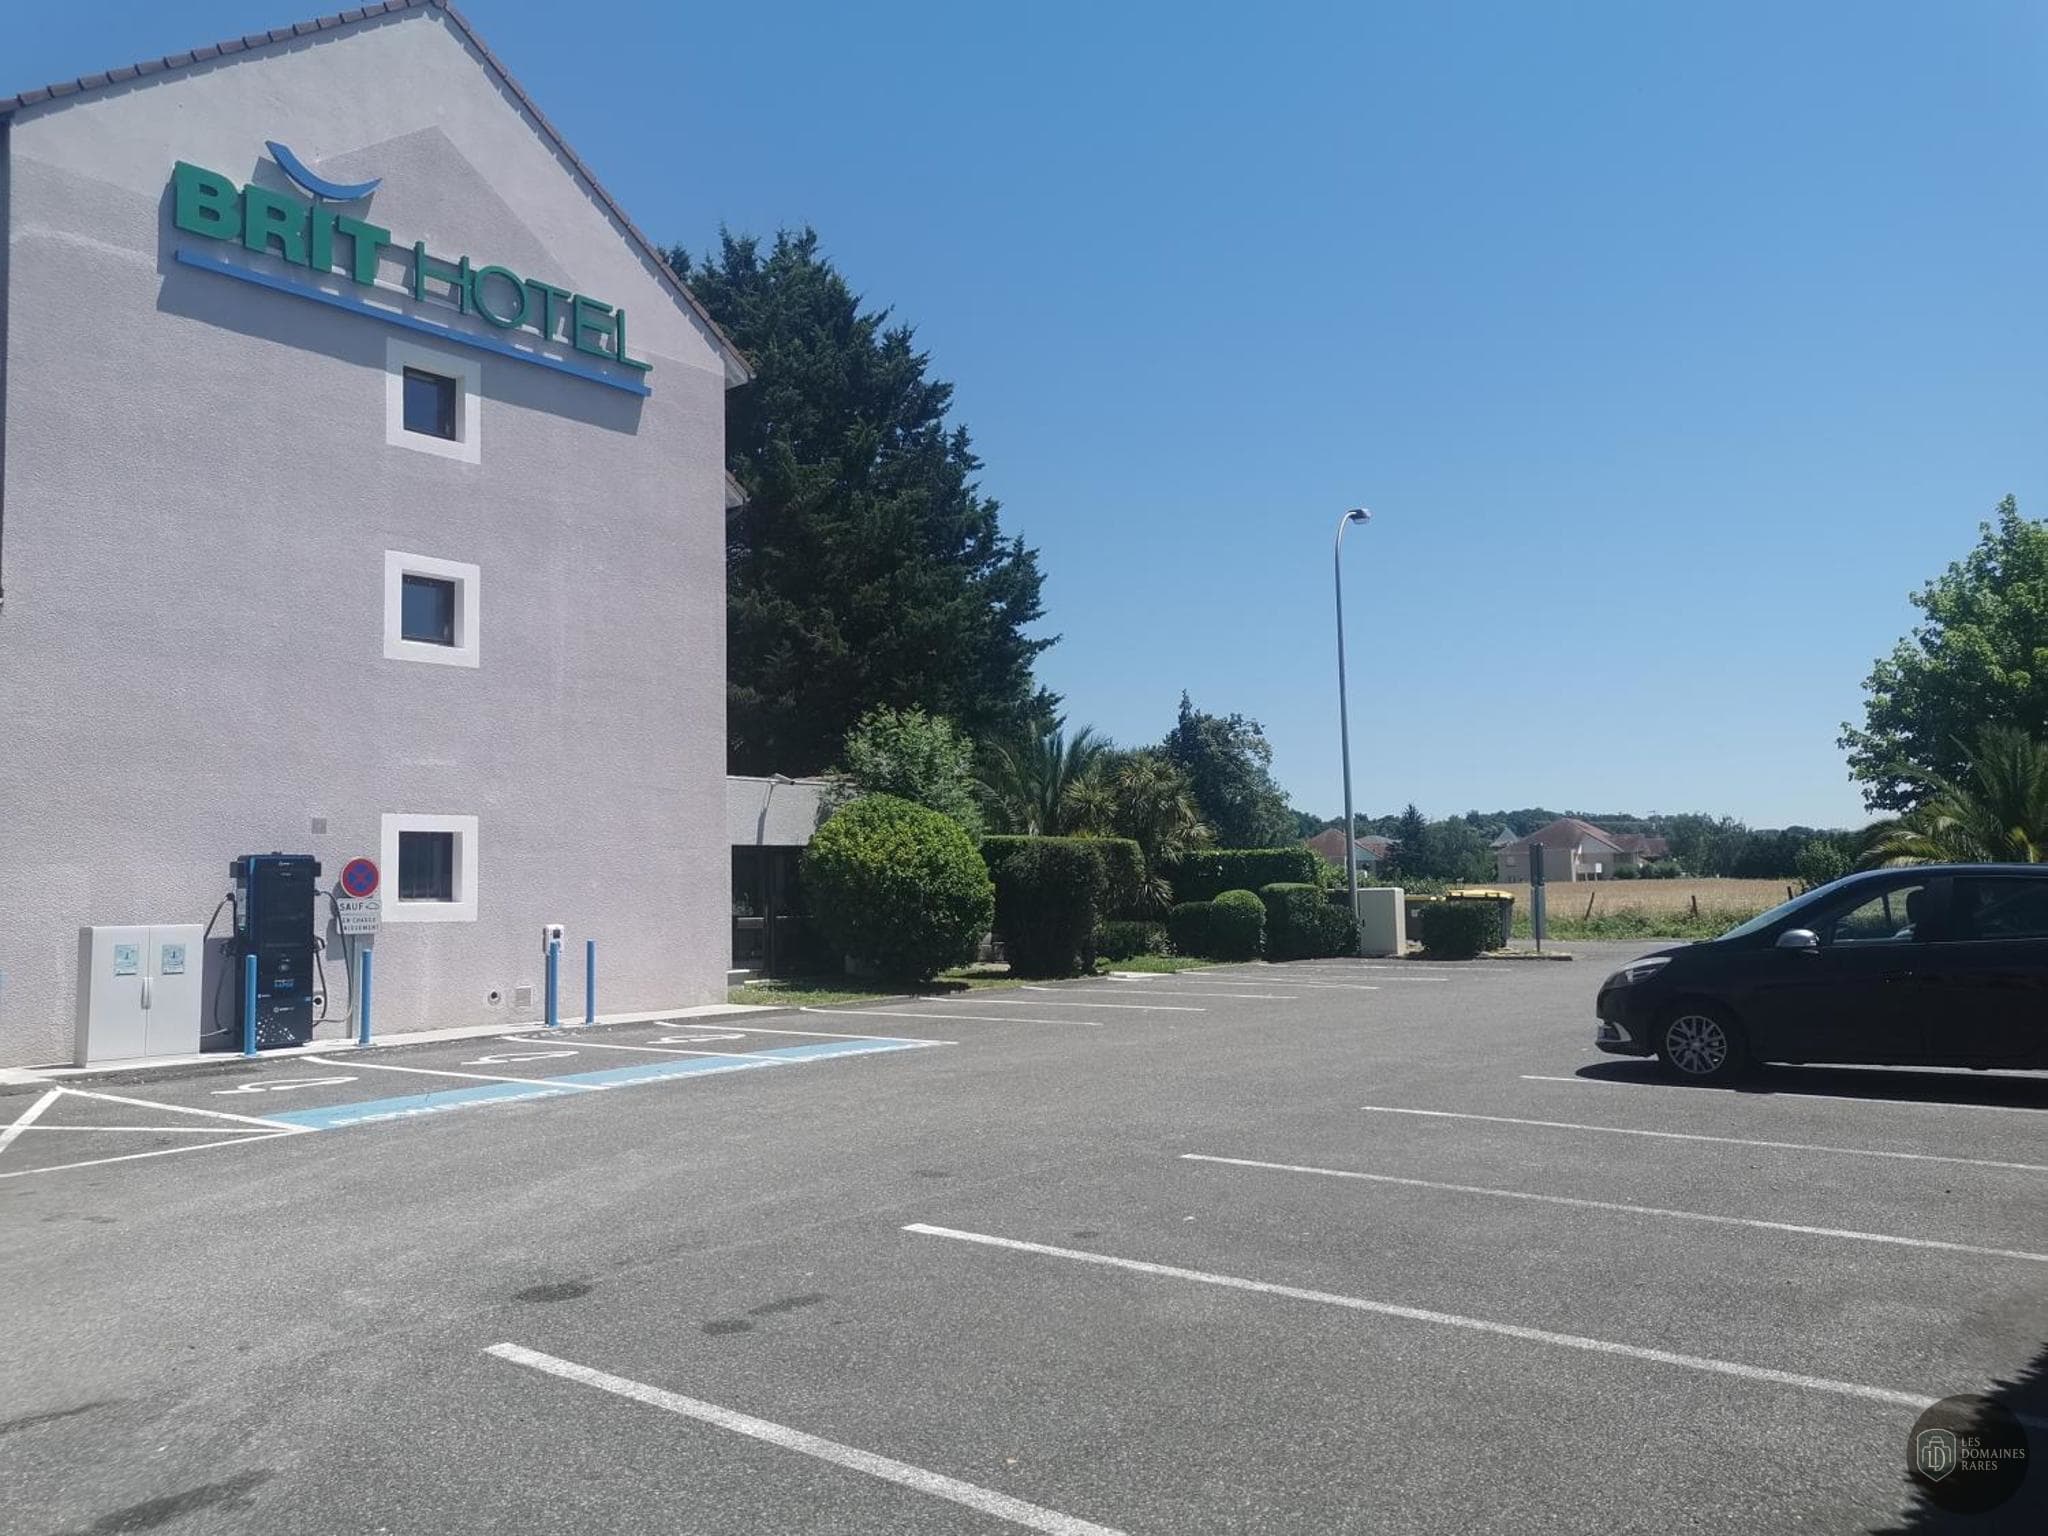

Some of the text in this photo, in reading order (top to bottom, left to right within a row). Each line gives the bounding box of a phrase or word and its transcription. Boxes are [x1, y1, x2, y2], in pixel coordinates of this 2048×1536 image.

[173, 159, 653, 372] BRIT HOTEL
[339, 902, 363, 911] SAUF
